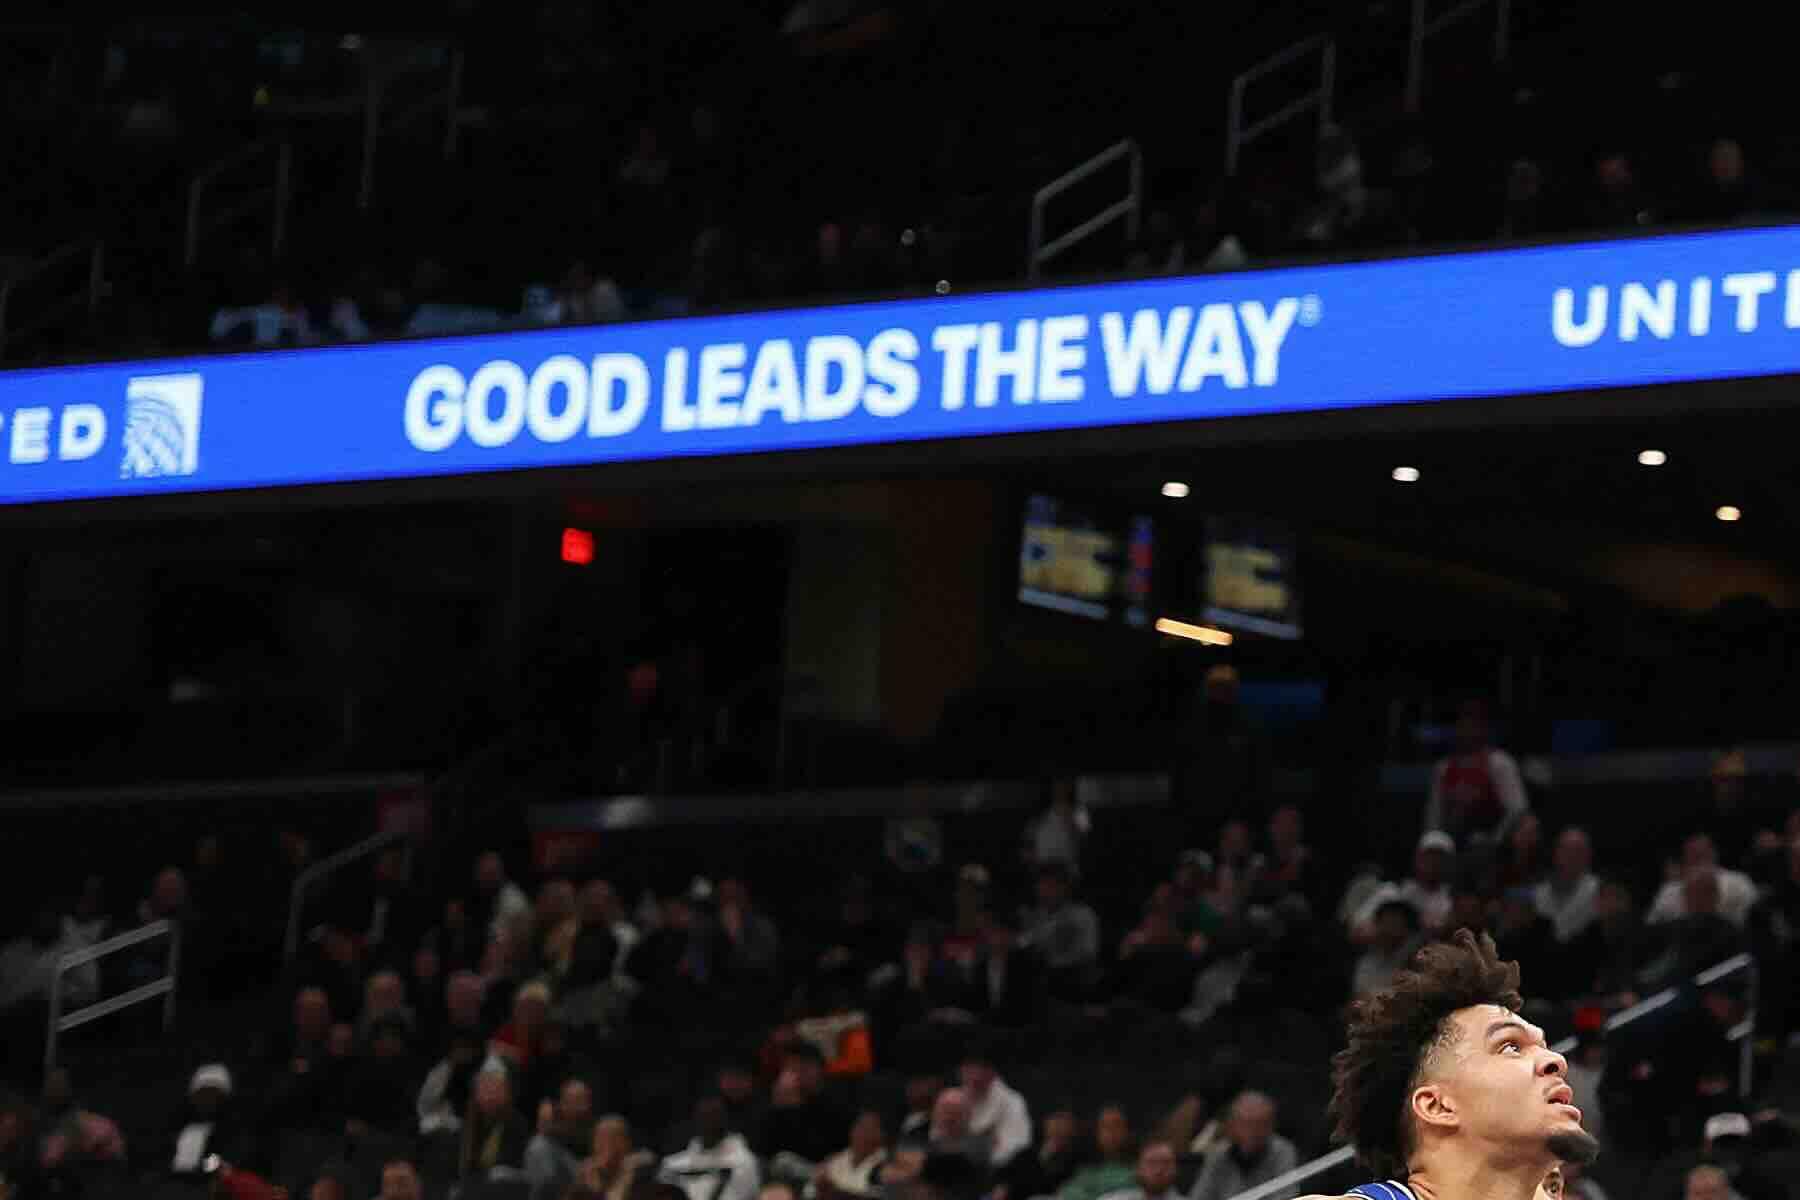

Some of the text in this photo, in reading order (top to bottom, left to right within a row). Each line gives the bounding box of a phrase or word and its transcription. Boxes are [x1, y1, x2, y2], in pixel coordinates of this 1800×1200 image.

[404, 353, 651, 452] GOOD
[662, 328, 920, 432] LEADS
[932, 314, 1090, 411] THE
[0, 404, 107, 464] ED
